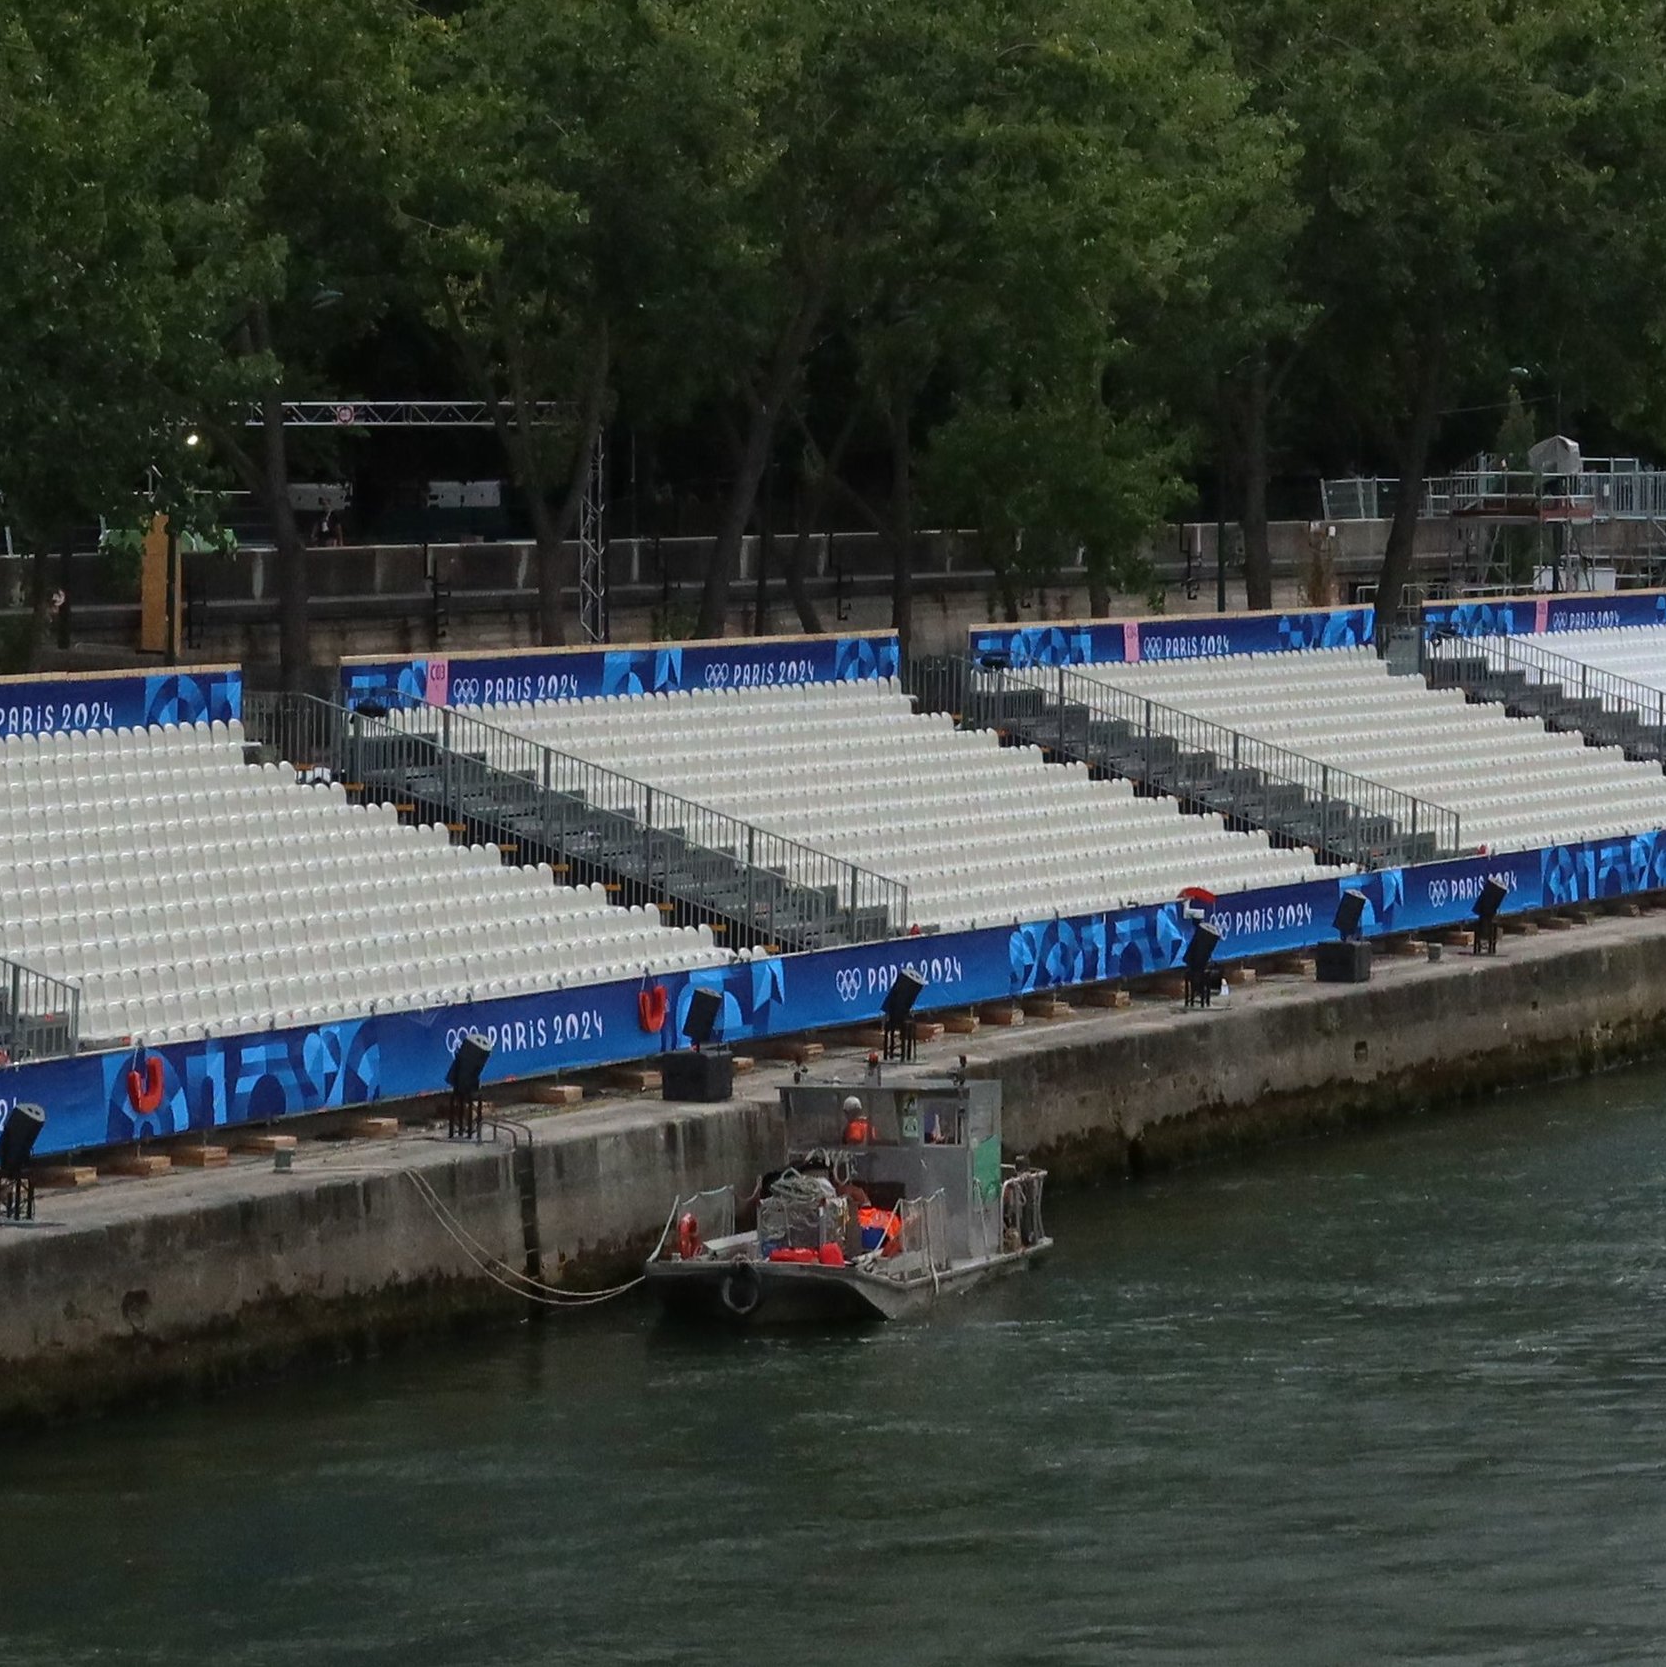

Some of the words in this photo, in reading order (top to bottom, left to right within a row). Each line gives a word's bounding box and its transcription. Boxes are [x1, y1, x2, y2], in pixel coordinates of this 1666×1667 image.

[1200, 634, 1230, 655] 2024
[778, 659, 815, 684] 2024
[537, 674, 578, 698] 2024
[62, 701, 113, 729] 2024
[1277, 902, 1312, 929] 2024
[920, 956, 962, 986] 2024
[553, 1010, 603, 1044] 2024
